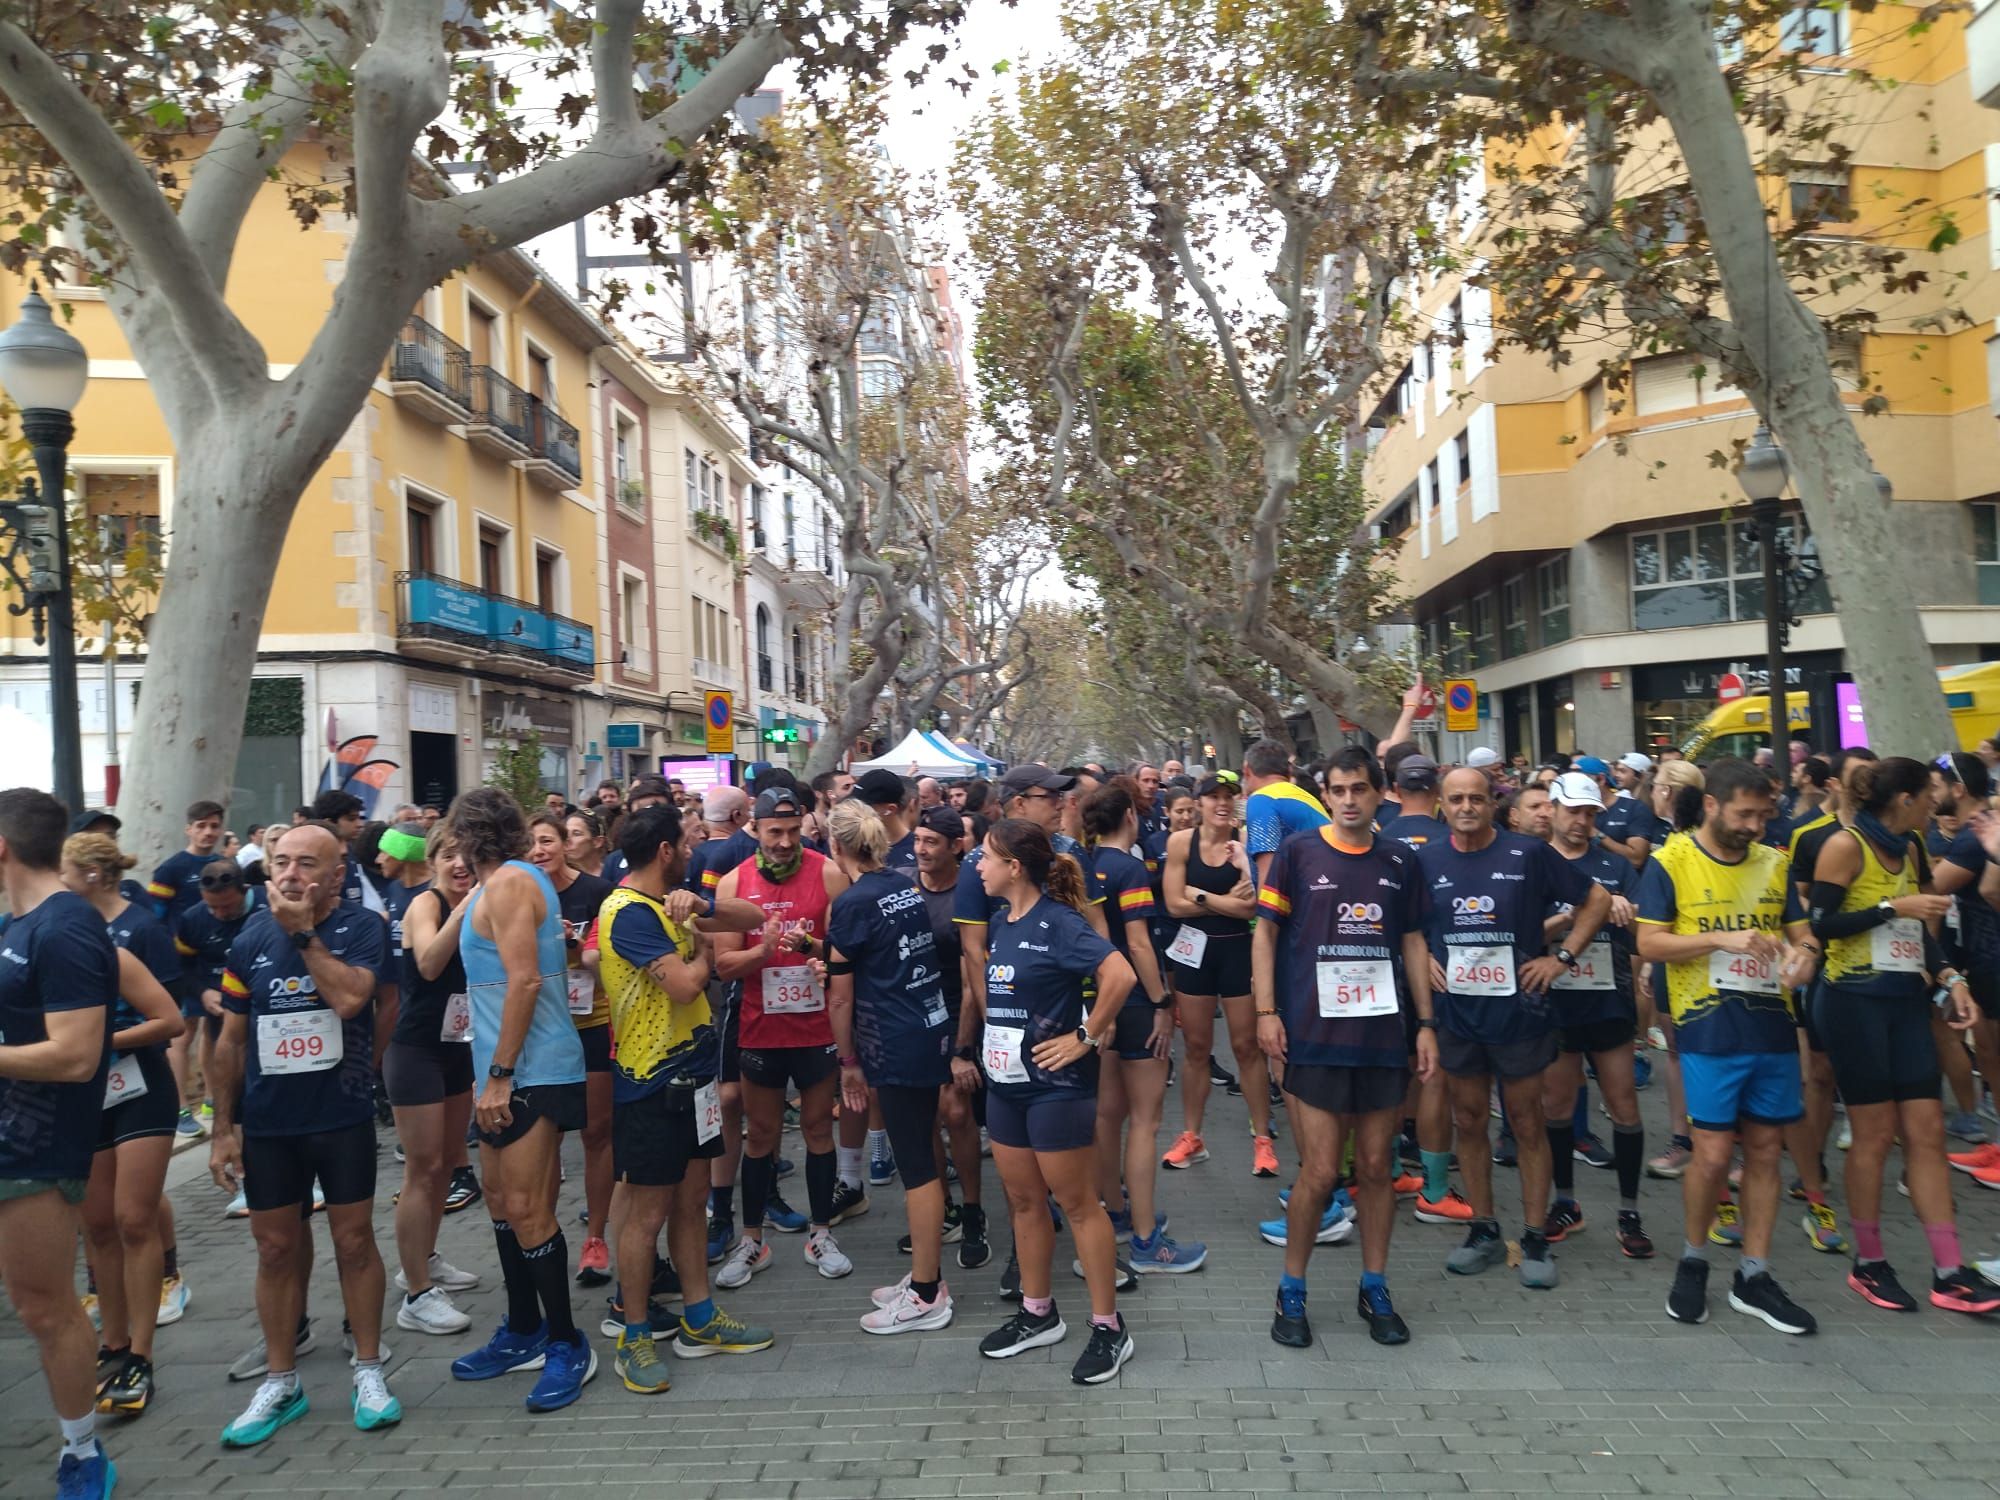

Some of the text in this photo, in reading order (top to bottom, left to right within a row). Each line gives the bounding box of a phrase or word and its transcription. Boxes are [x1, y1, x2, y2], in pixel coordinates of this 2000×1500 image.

[1455, 966, 1506, 983] 2496
[777, 984, 814, 1002] 334
[1336, 984, 1377, 1004] 511
[275, 1036, 324, 1059] 499
[986, 1049, 1009, 1072] 257
